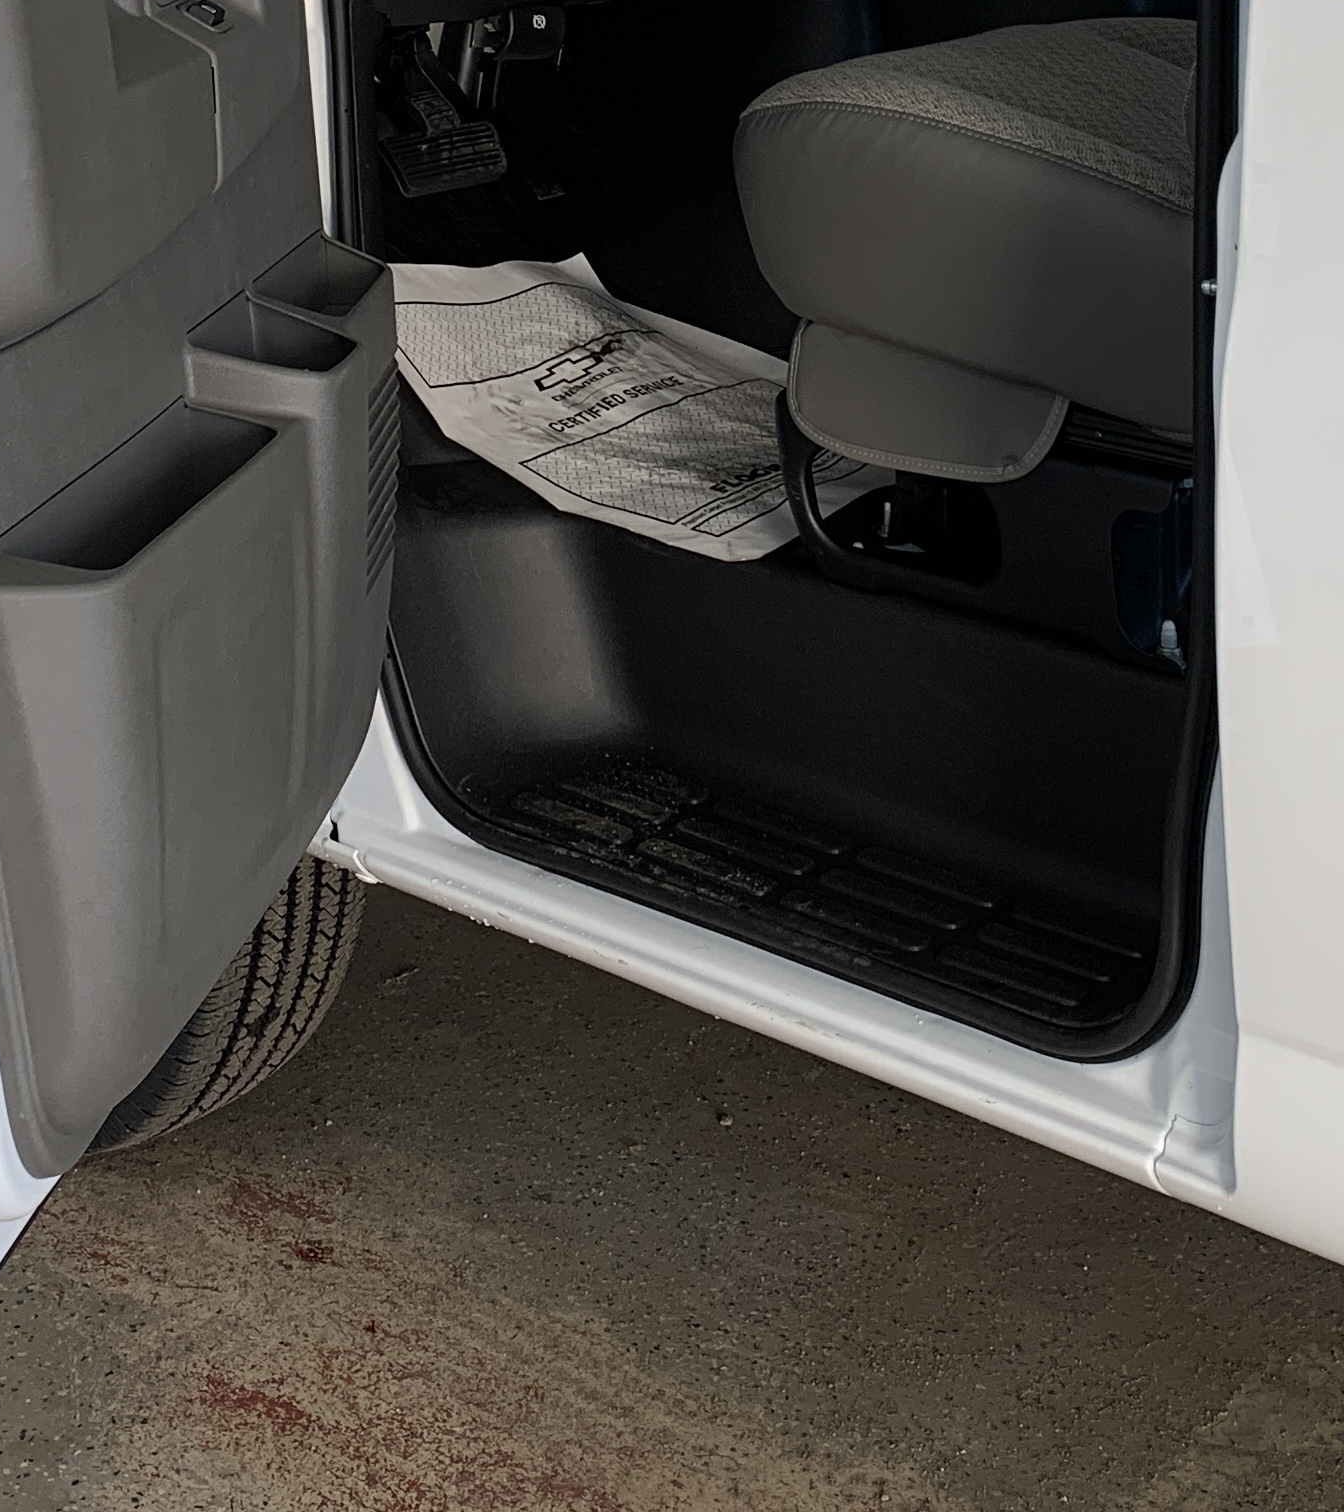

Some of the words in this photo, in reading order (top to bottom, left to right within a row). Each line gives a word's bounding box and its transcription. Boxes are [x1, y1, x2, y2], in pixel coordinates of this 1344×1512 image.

[548, 393, 627, 433] CERTIFIED
[622, 375, 685, 399] SERVICE
[551, 366, 624, 402] CHEVROLET
